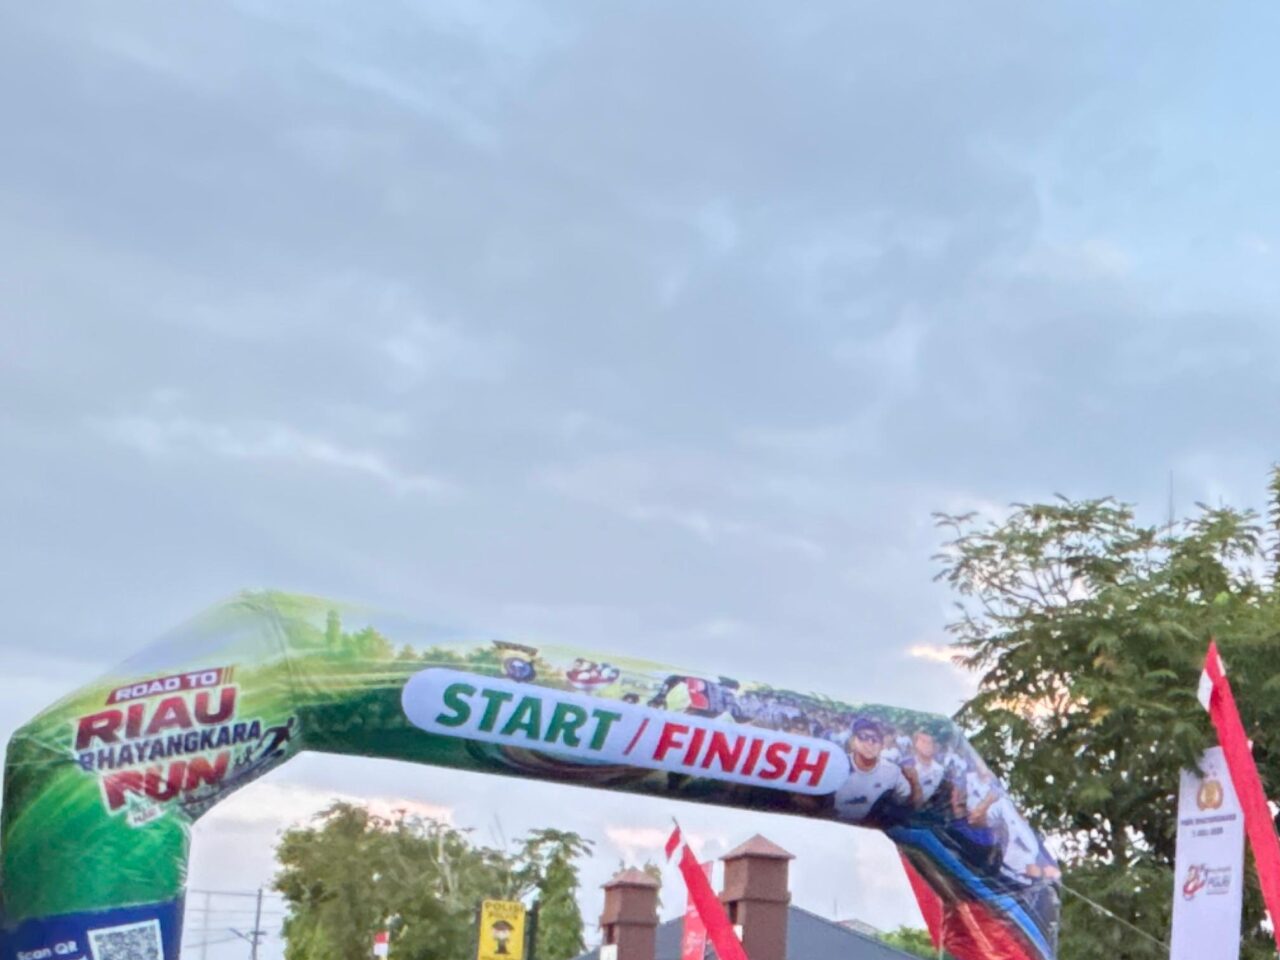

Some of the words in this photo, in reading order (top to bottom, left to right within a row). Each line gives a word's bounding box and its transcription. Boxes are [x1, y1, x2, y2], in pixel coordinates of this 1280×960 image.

[115, 677, 181, 701] ROAD
[187, 671, 218, 687] TO
[75, 687, 237, 750] RIAU
[79, 720, 262, 772] BHAYANGKARA
[435, 683, 621, 750] START
[653, 721, 831, 788] FINISH
[103, 751, 231, 811] RUN
[54, 940, 78, 955] QR
